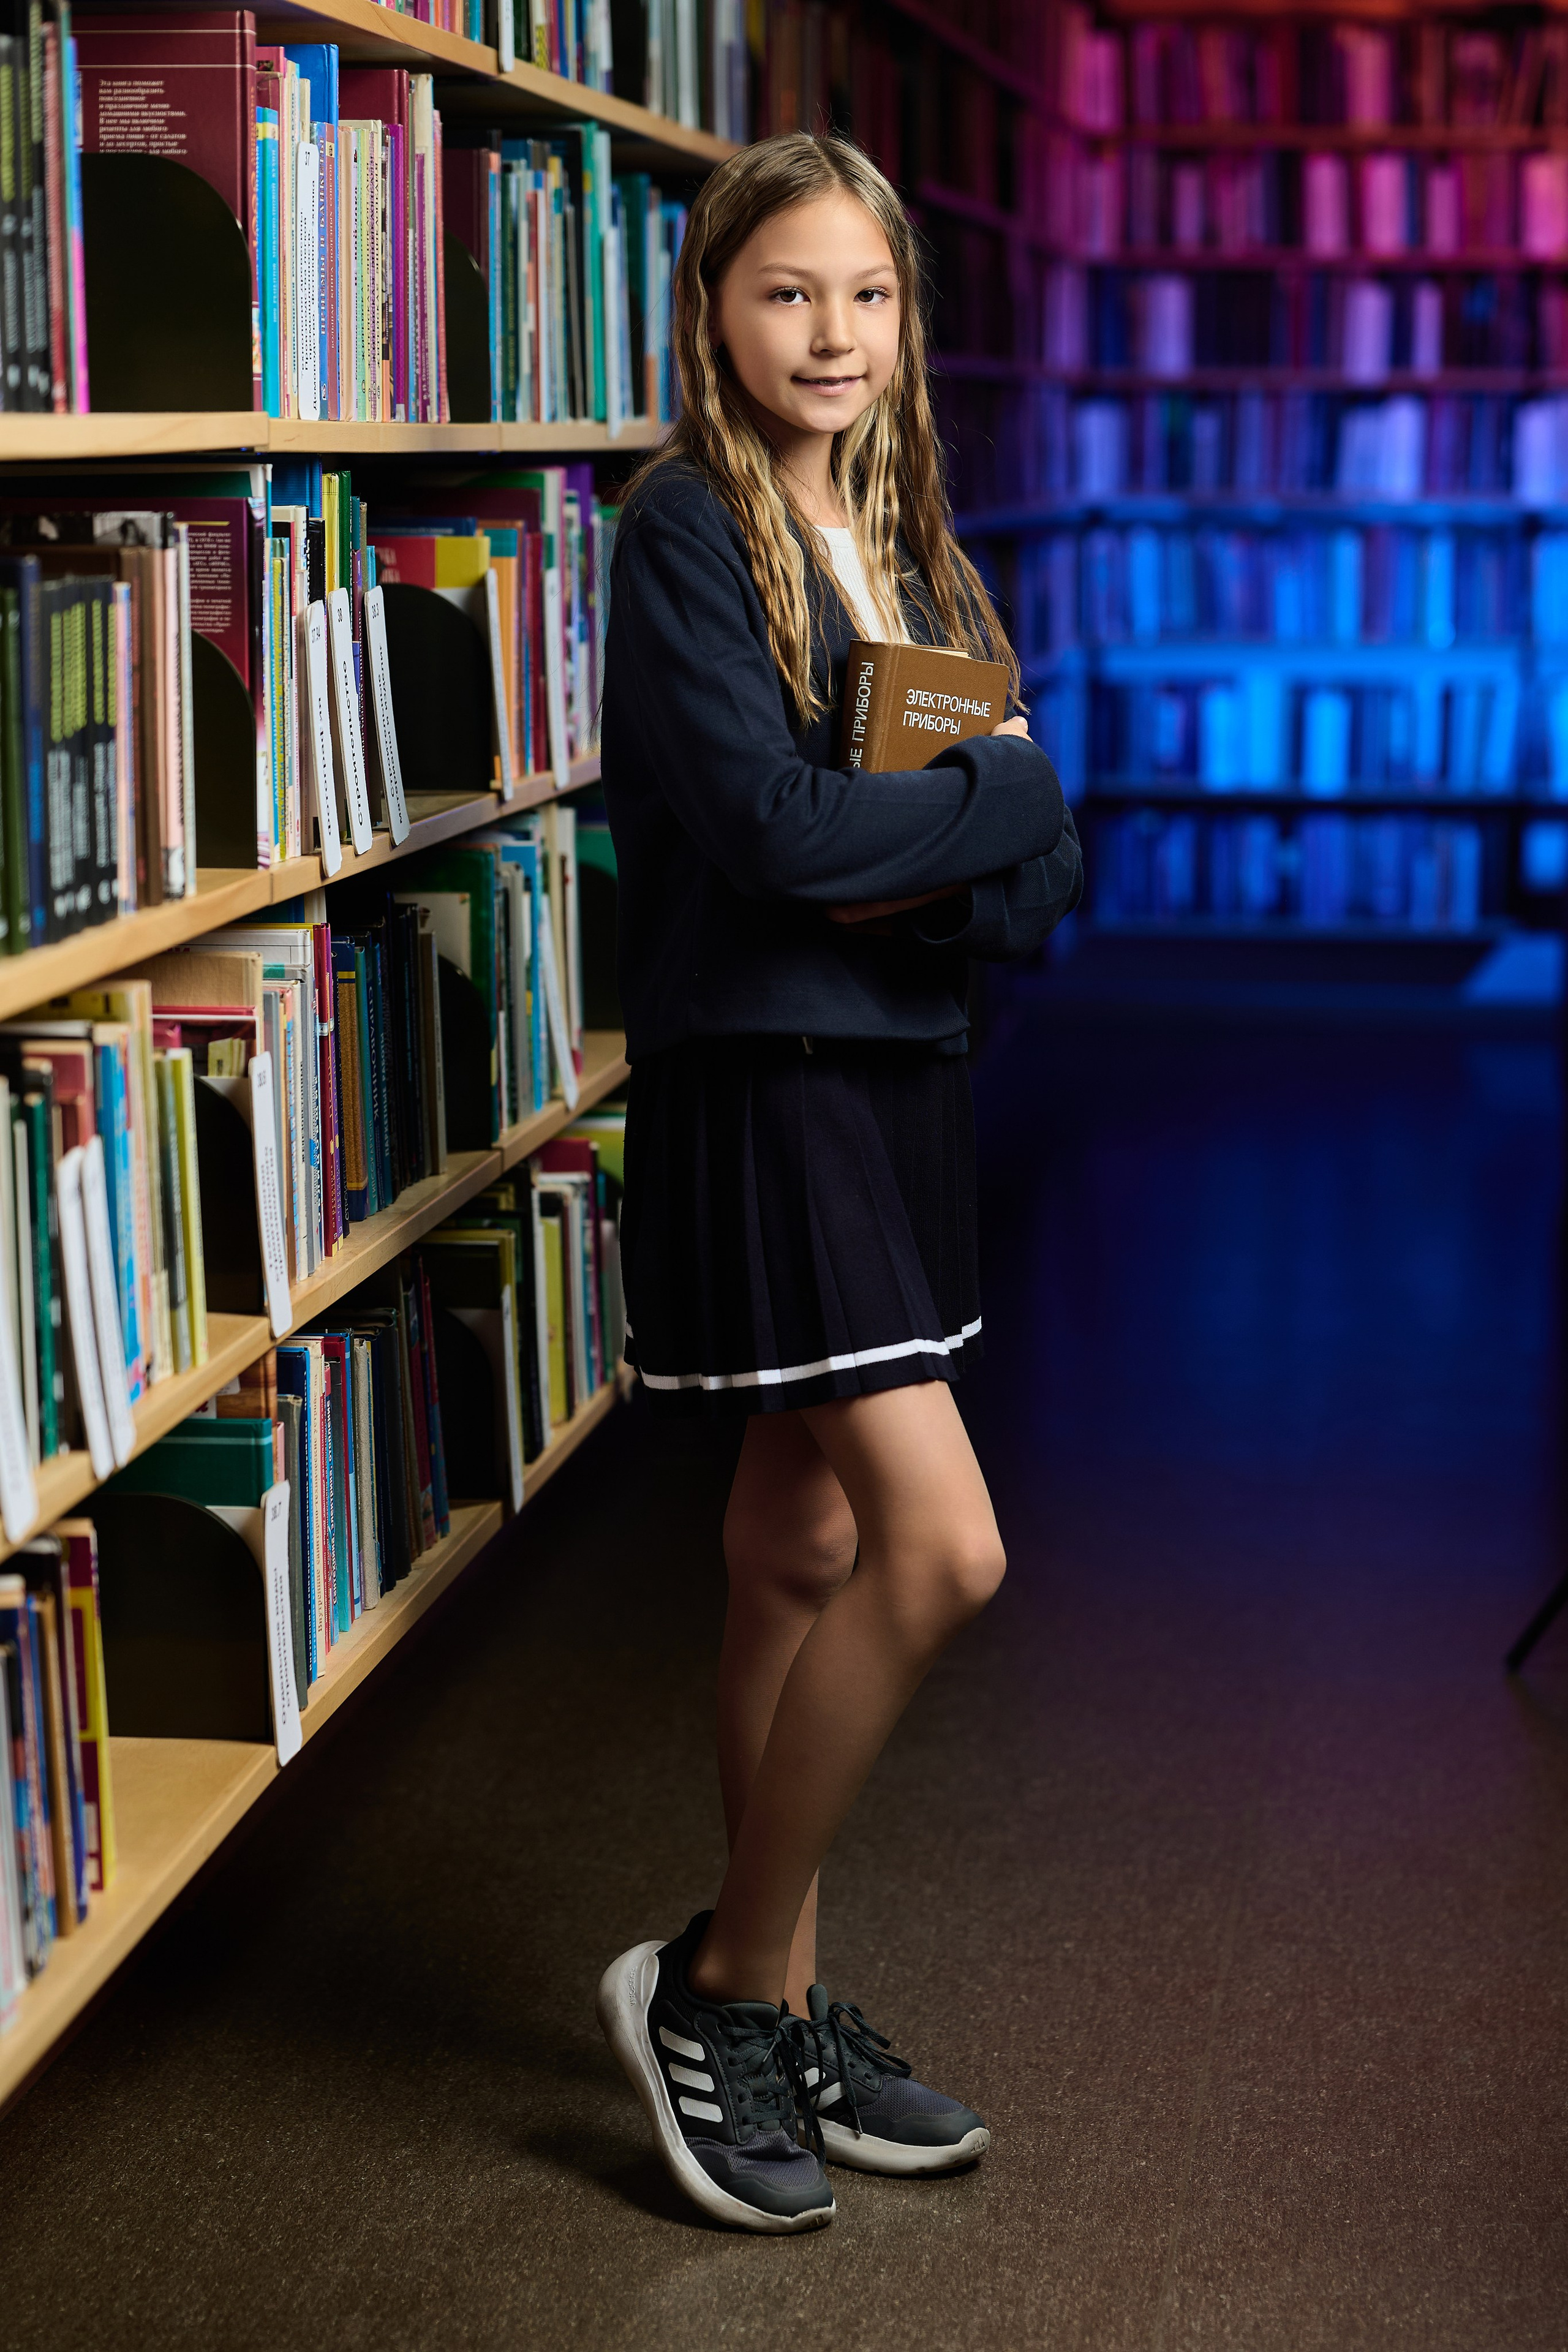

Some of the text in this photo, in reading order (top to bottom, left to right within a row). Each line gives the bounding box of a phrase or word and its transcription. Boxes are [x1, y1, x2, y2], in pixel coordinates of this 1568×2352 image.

[113, 87, 164, 96] разнообразить
[304, 151, 311, 167] 37
[320, 236, 325, 248] И
[337, 608, 343, 623] 38
[851, 662, 874, 742] ПРИБОРЫ
[906, 688, 992, 717] ЭЛЕКТРОННЫЕ
[386, 716, 390, 726] и
[903, 710, 962, 735] ПРИБОРЫ
[342, 660, 363, 826] Строительство
[378, 674, 394, 798] Строительные
[369, 986, 379, 1121] СПРАВОЧНИК
